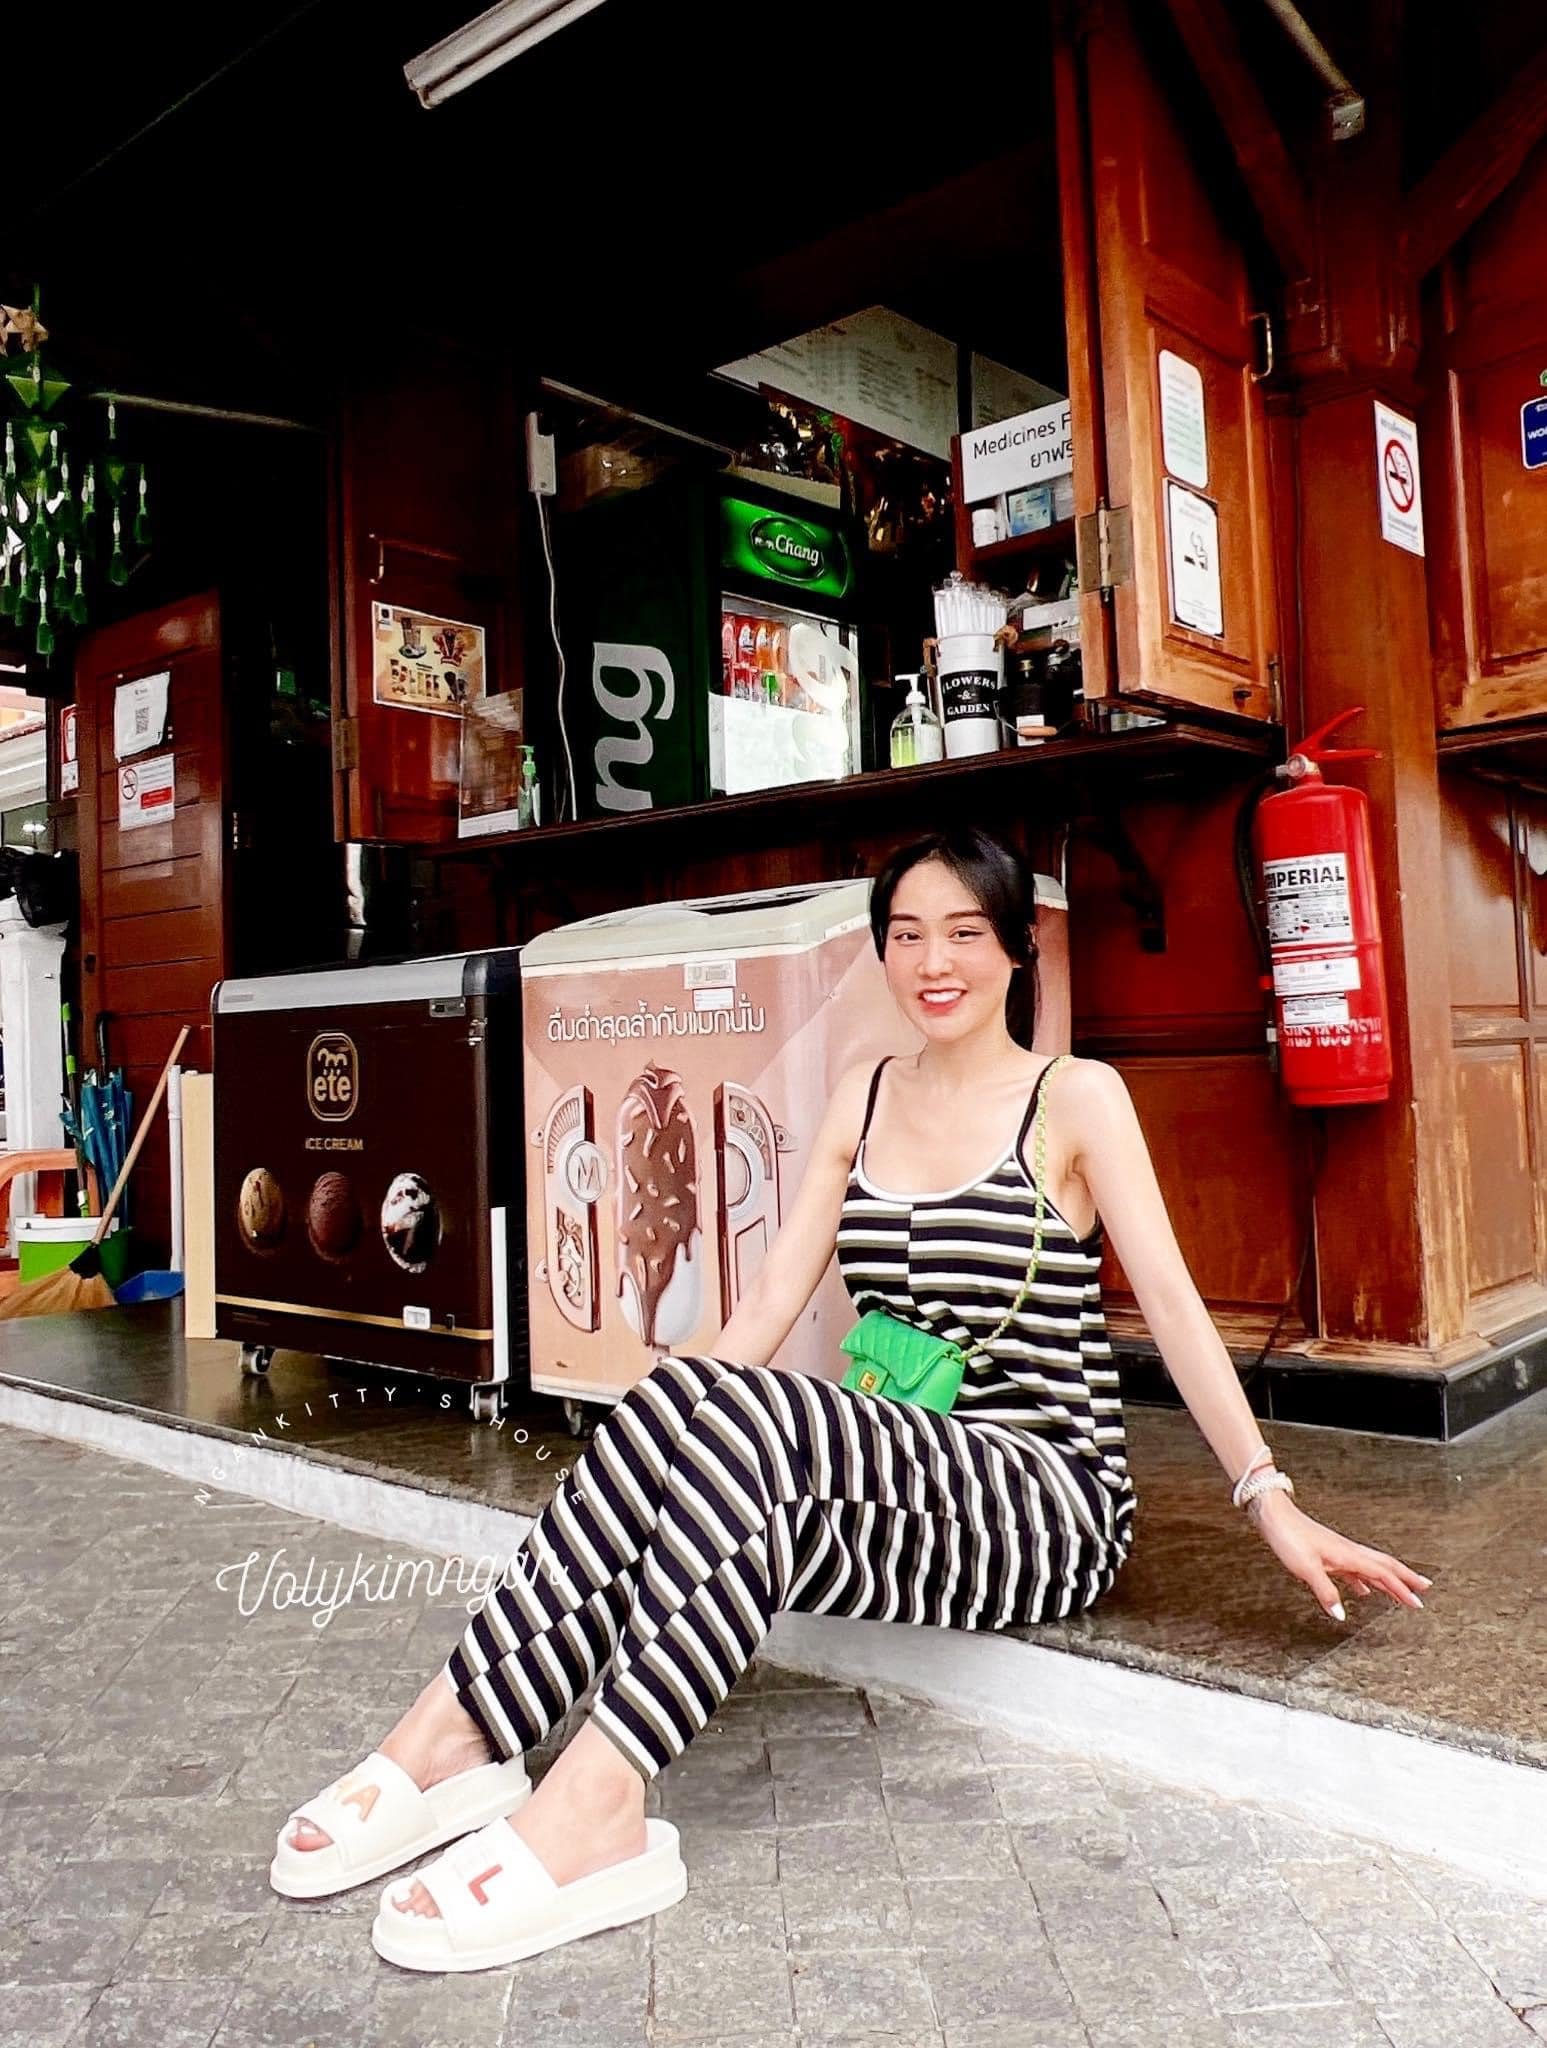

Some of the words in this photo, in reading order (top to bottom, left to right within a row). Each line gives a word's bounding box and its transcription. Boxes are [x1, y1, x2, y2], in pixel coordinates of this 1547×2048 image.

[973, 420, 1056, 460] Medicines
[1060, 410, 1072, 431] F
[1527, 425, 1547, 441] WO
[775, 534, 819, 567] Chang
[946, 703, 990, 716] GARDEN
[304, 1137, 323, 1150] ICE
[324, 1137, 364, 1151] CREAM
